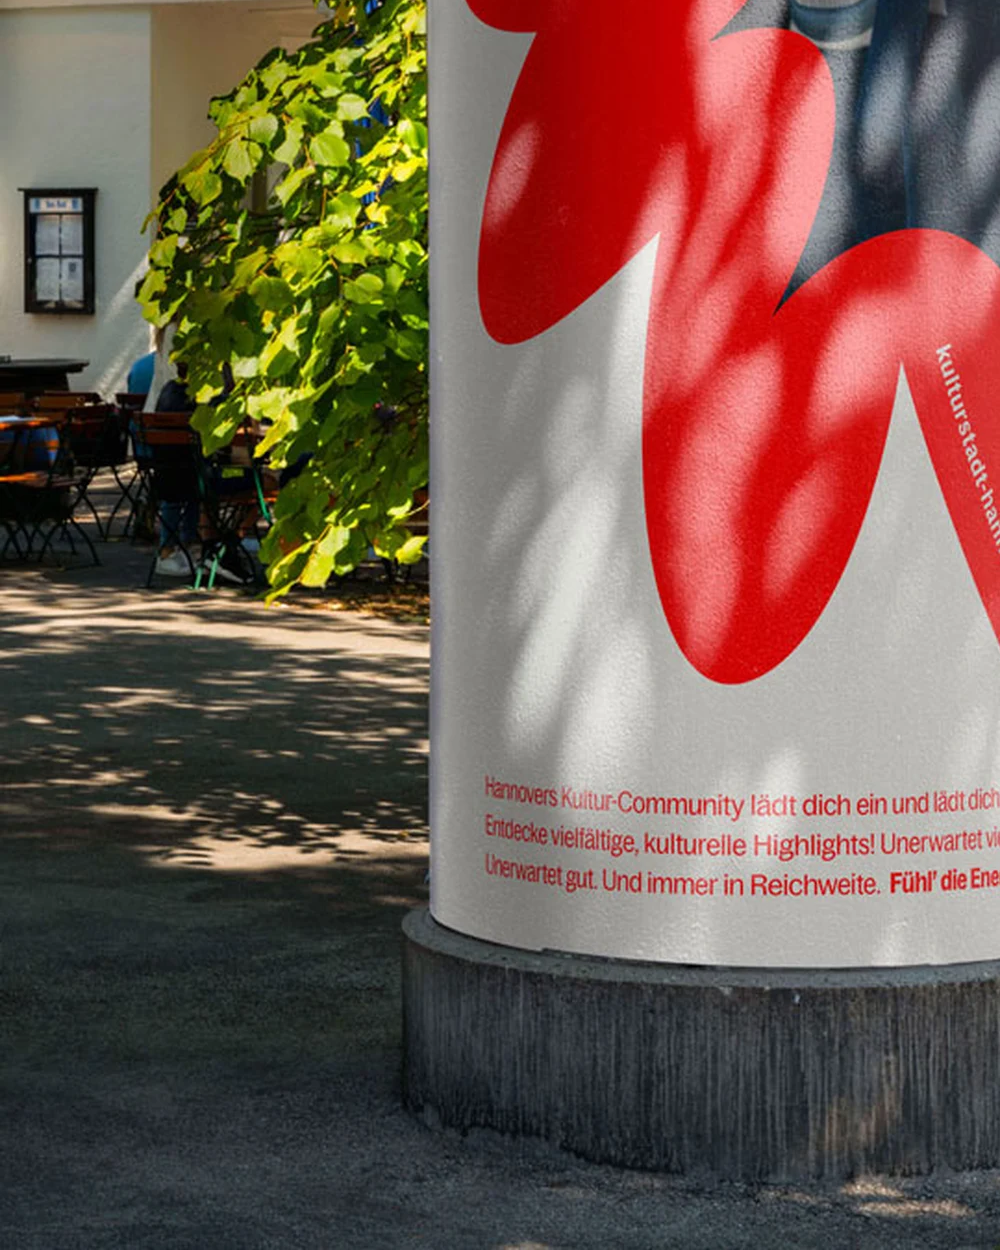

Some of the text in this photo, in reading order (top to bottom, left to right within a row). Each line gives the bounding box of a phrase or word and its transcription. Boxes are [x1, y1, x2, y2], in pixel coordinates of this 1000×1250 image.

[485, 774, 558, 807] Hannovers
[561, 786, 745, 822] Kultur-Community
[751, 794, 798, 817] lädt
[802, 794, 851, 817] dich
[856, 793, 888, 815] ein
[892, 792, 929, 815] und
[933, 790, 965, 813] lädt
[968, 787, 1000, 810] dich
[485, 814, 548, 845] Entdecke
[551, 826, 640, 858] vielfältige,
[644, 832, 747, 856] kulturelle
[753, 834, 875, 862] Highlights!
[880, 829, 982, 855] Unerwartet
[485, 852, 562, 887] Unerwartet
[565, 867, 597, 893] gut.
[603, 868, 643, 893] Und
[647, 871, 719, 896] immer
[723, 873, 744, 896] in
[750, 872, 880, 897] Reichweite.
[940, 869, 968, 892] die
